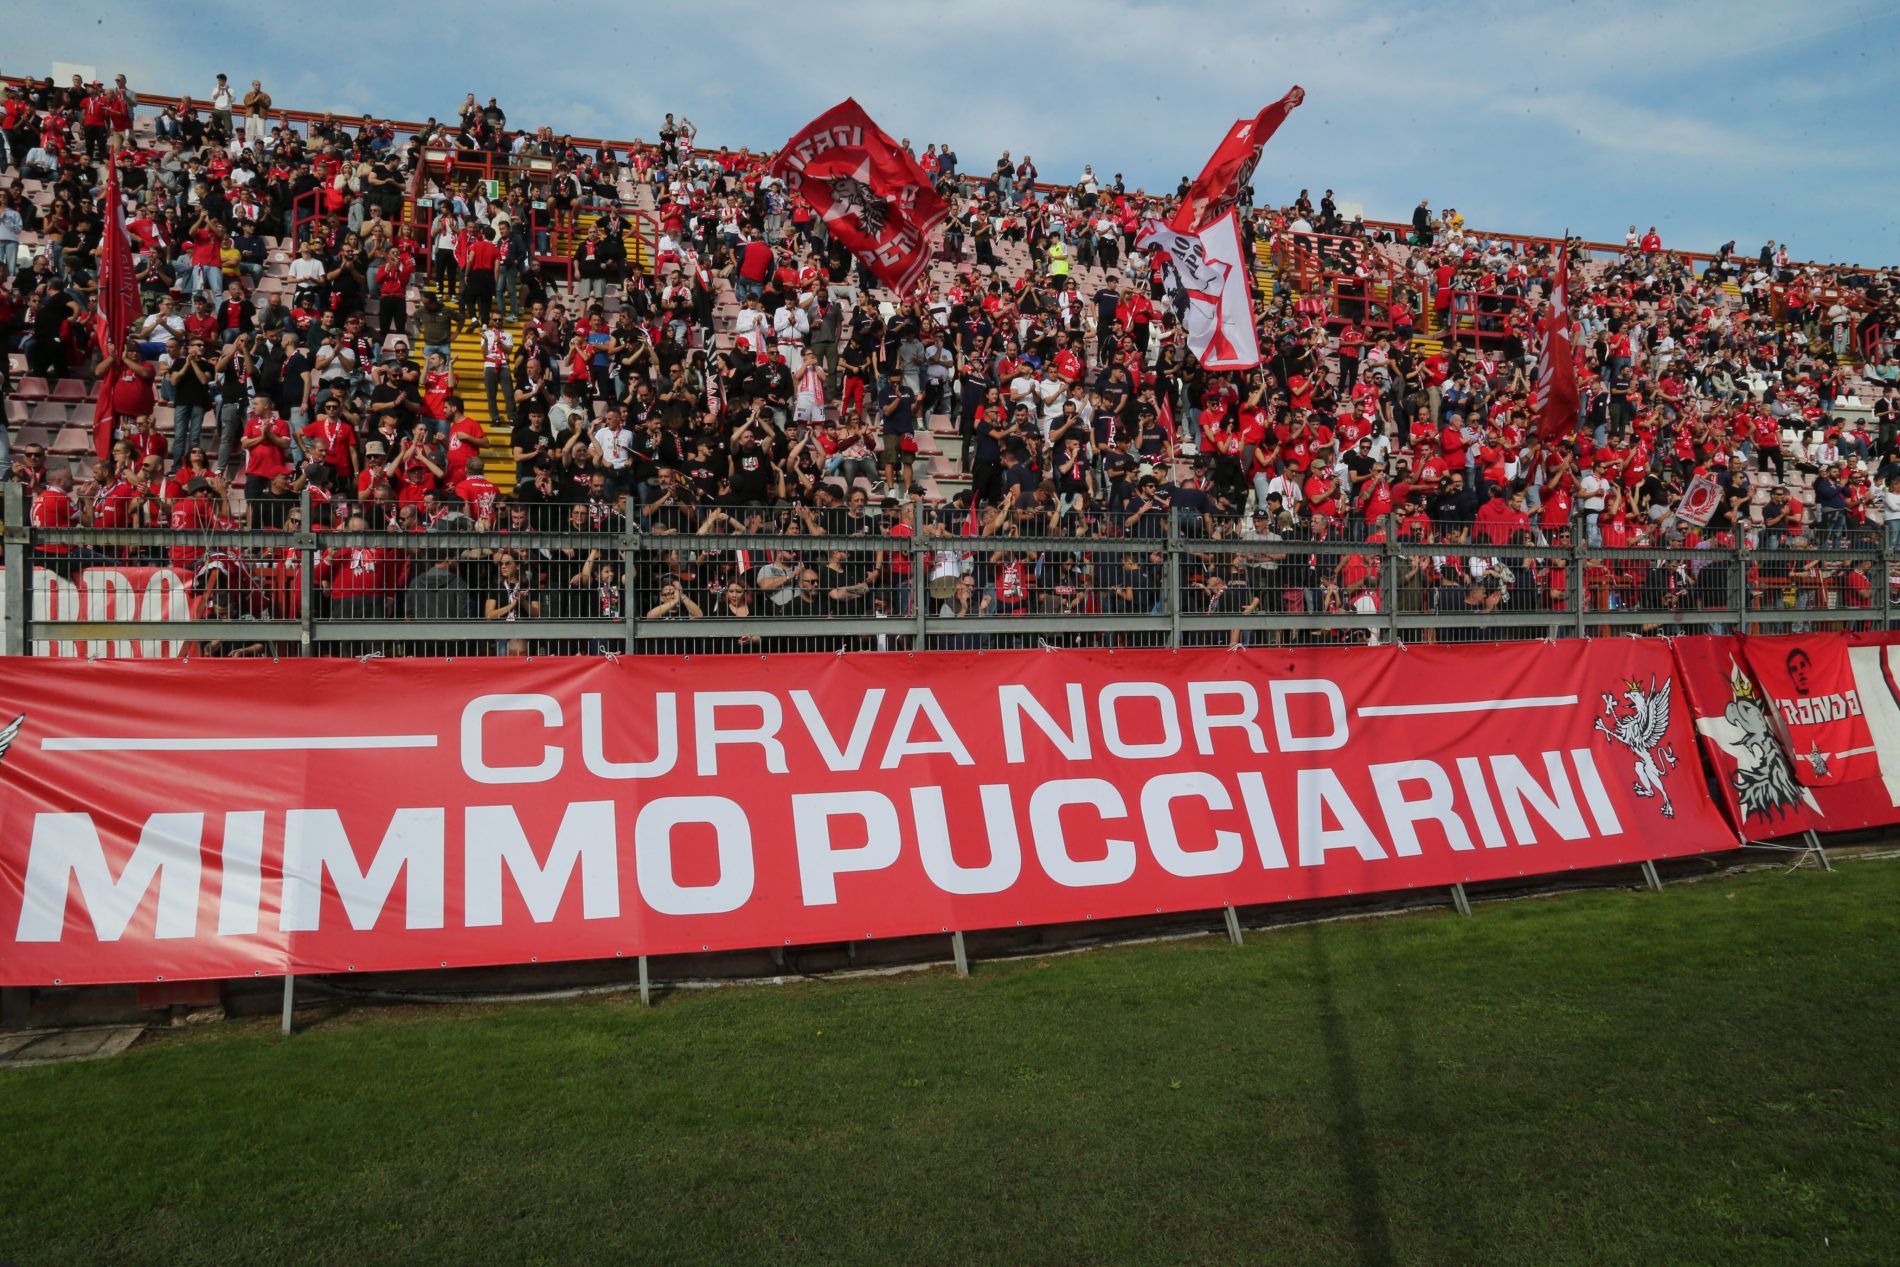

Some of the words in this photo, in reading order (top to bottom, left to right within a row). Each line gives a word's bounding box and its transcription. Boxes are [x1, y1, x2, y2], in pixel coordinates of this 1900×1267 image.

[461, 687, 975, 786] CURVA
[999, 678, 1350, 765] NORD
[1776, 689, 1863, 725] RONDO
[16, 796, 755, 944] MIMMO
[792, 749, 1623, 907] PUCCIARINI
